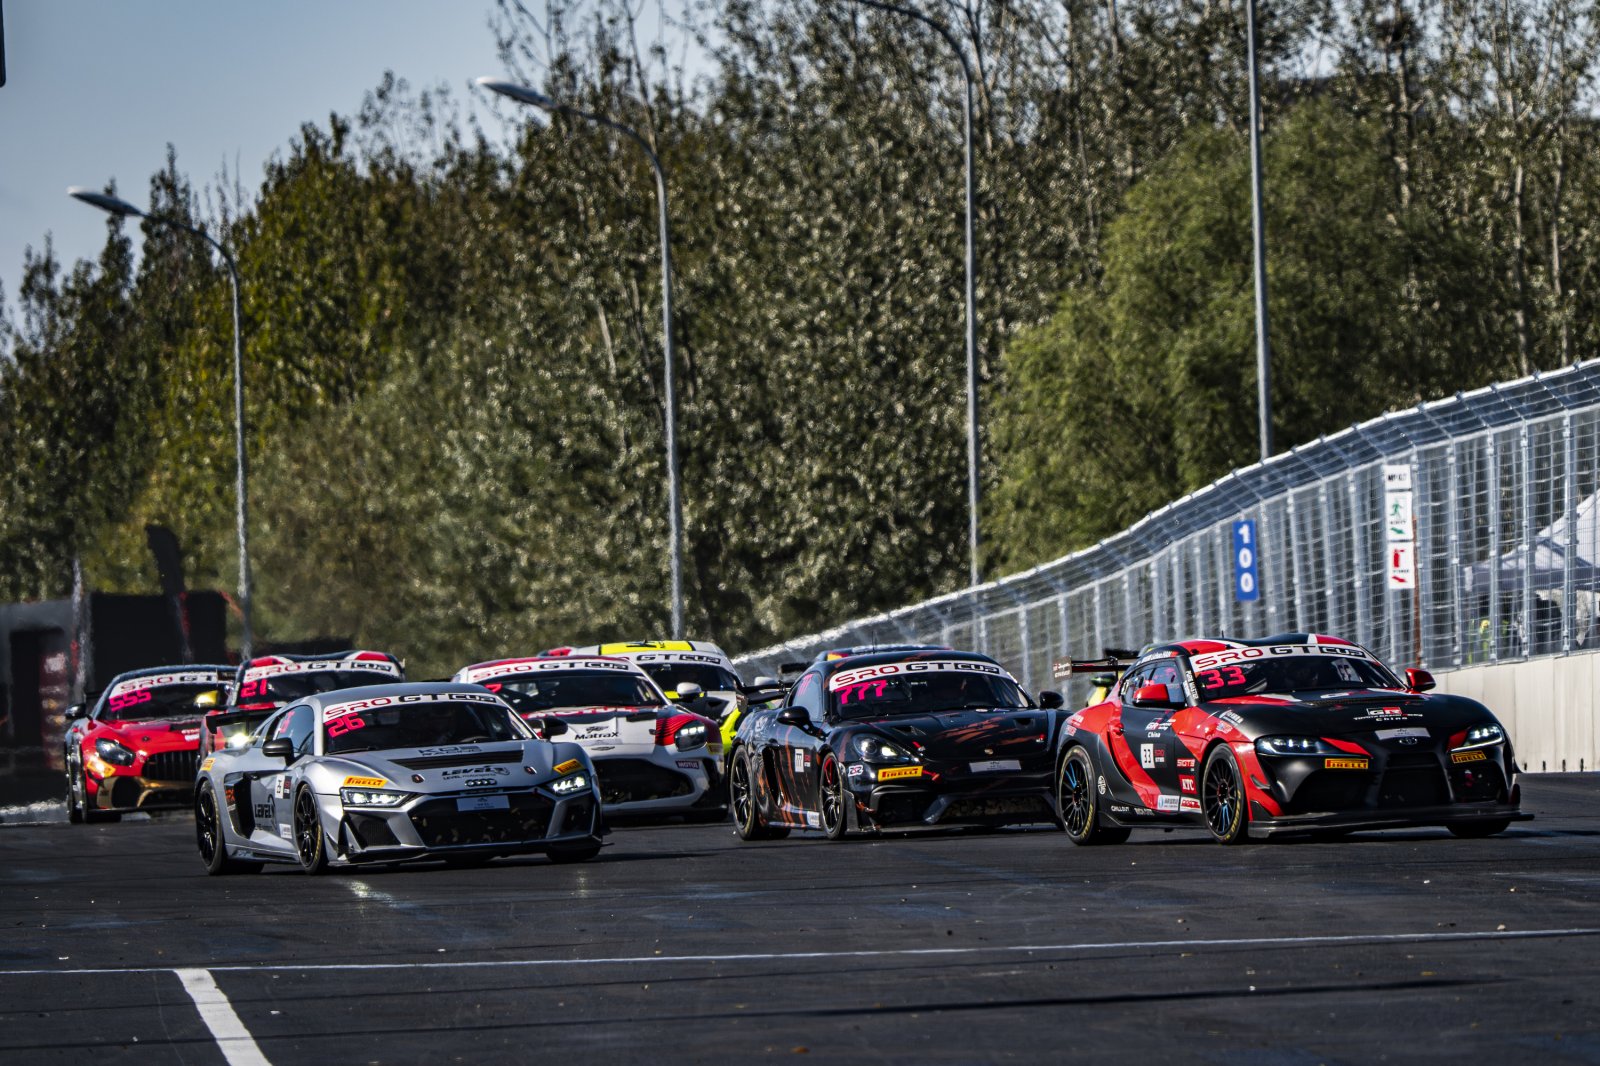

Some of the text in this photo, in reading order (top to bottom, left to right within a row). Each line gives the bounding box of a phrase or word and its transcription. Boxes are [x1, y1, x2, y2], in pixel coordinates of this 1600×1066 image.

[1238, 524, 1254, 593] 100
[636, 653, 677, 661] GT
[679, 654, 721, 664] CUP
[1195, 646, 1367, 668] SRO GT CUP
[246, 660, 392, 680] SRO GT CUP
[473, 664, 532, 680] SRO
[585, 661, 629, 670] CUP
[835, 661, 1001, 686] SRO GT CUP
[1200, 665, 1247, 690] 33
[120, 675, 173, 690] SRO
[240, 678, 268, 698] 21
[835, 680, 887, 705] 777
[109, 687, 152, 712] 555
[324, 693, 498, 718] SRO GT CUP
[323, 711, 366, 738] 26
[1143, 749, 1152, 764] 33
[1327, 759, 1367, 768] PIRELLI
[1454, 752, 1485, 763] PIRELLI
[346, 777, 384, 787] PIRELLI
[881, 767, 919, 778] PIRELLI
[1182, 778, 1195, 791] KTC
